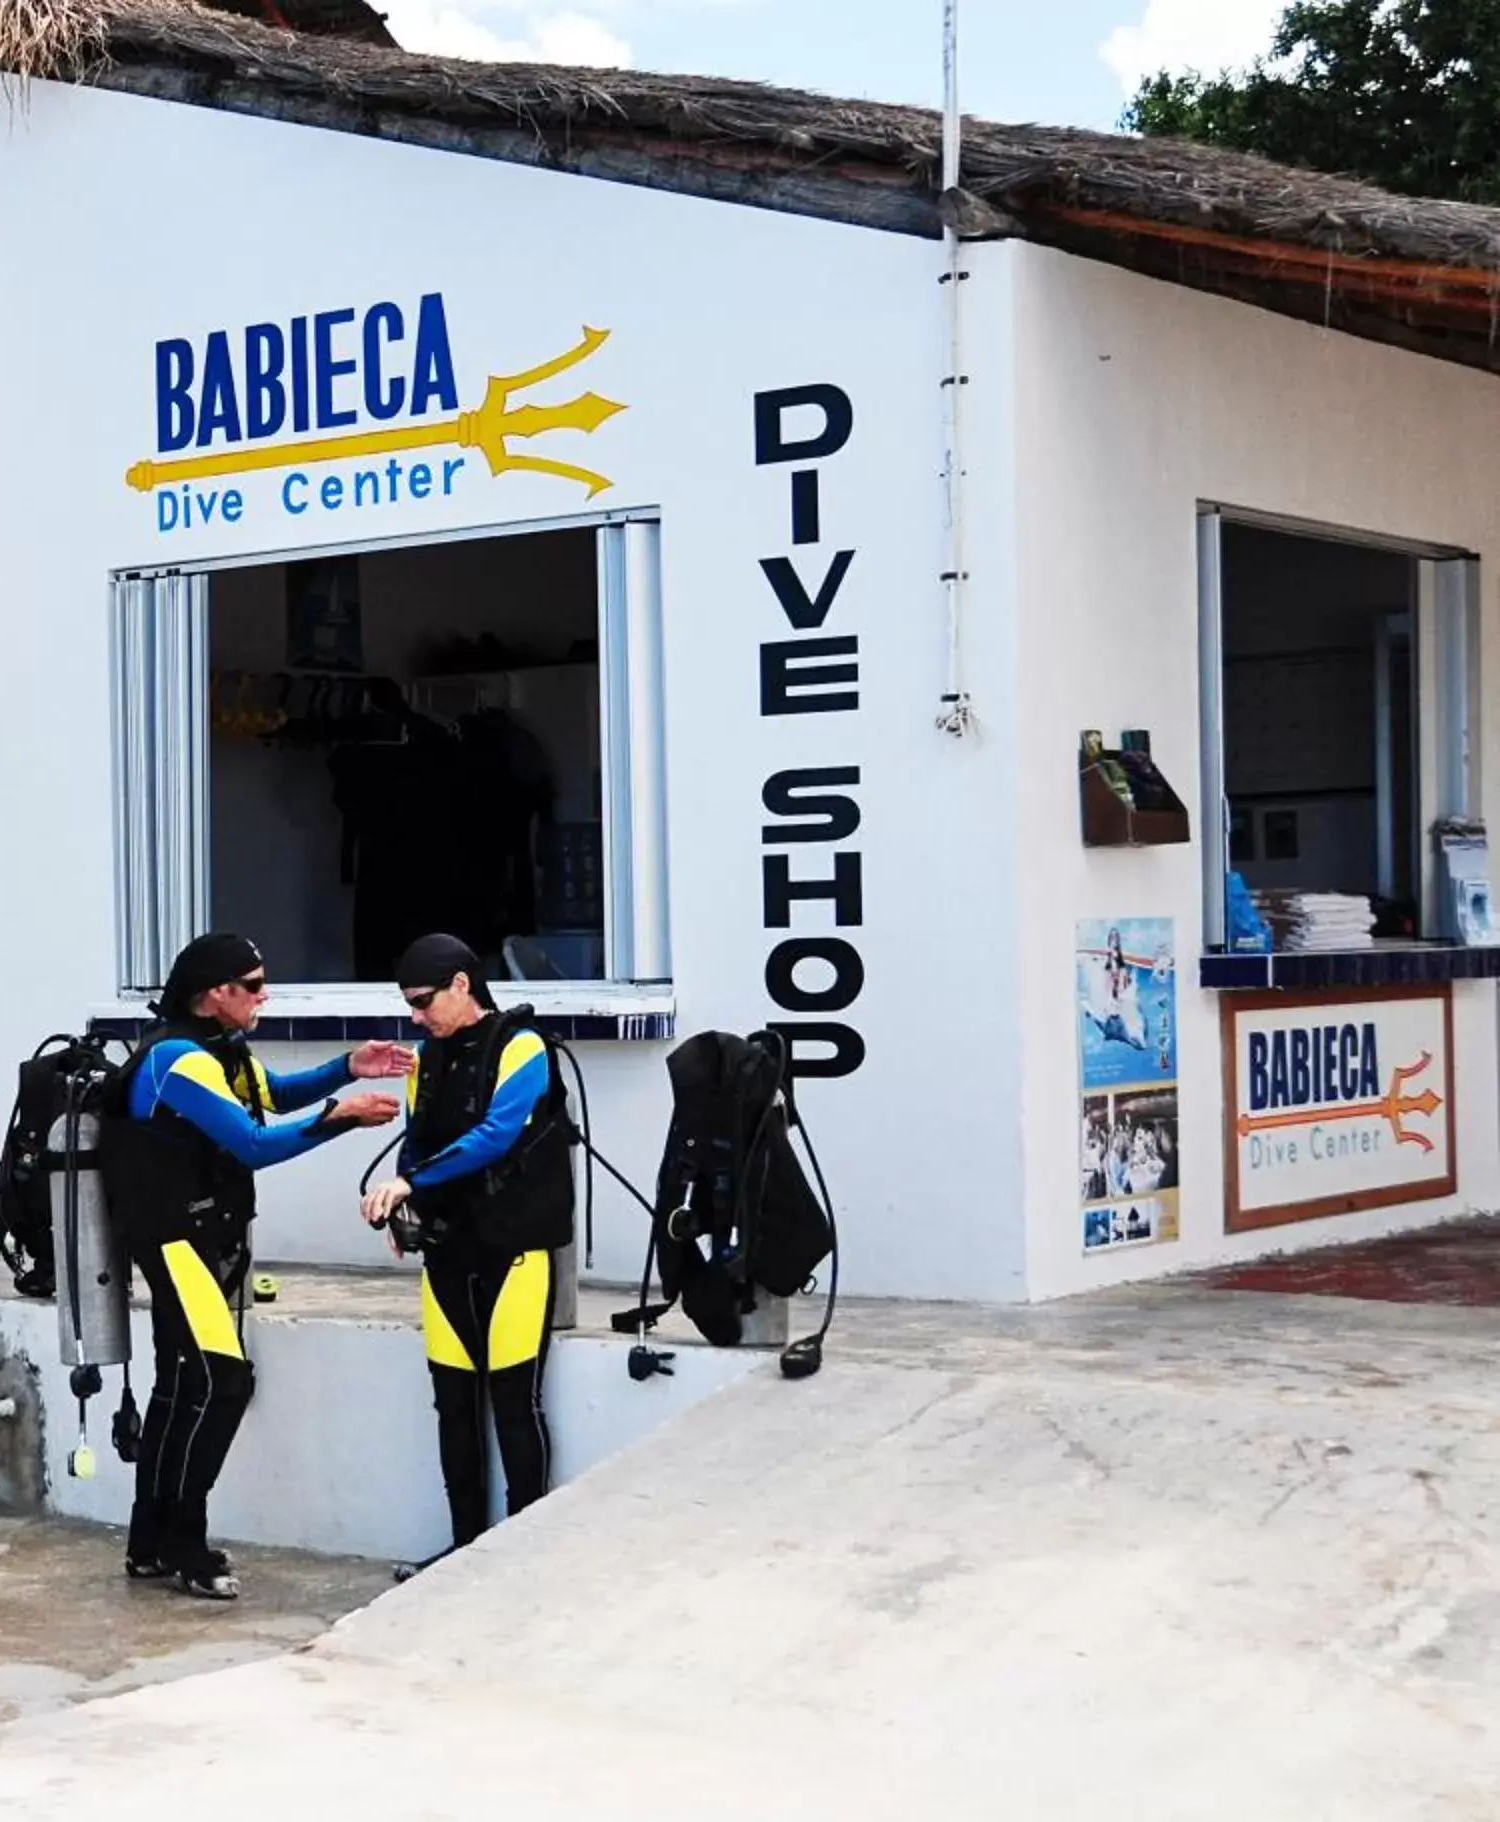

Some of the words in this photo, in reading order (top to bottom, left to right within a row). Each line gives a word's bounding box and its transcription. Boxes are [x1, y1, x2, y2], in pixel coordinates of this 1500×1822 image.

[156, 292, 459, 453] BABIECA
[158, 484, 243, 532] Dive
[282, 457, 465, 515] Center
[754, 383, 860, 717] DIVE
[761, 765, 866, 1094] SHOP
[1248, 1022, 1380, 1111] BABIECA
[1251, 1135, 1298, 1170] Dive
[1310, 1125, 1381, 1161] Center
